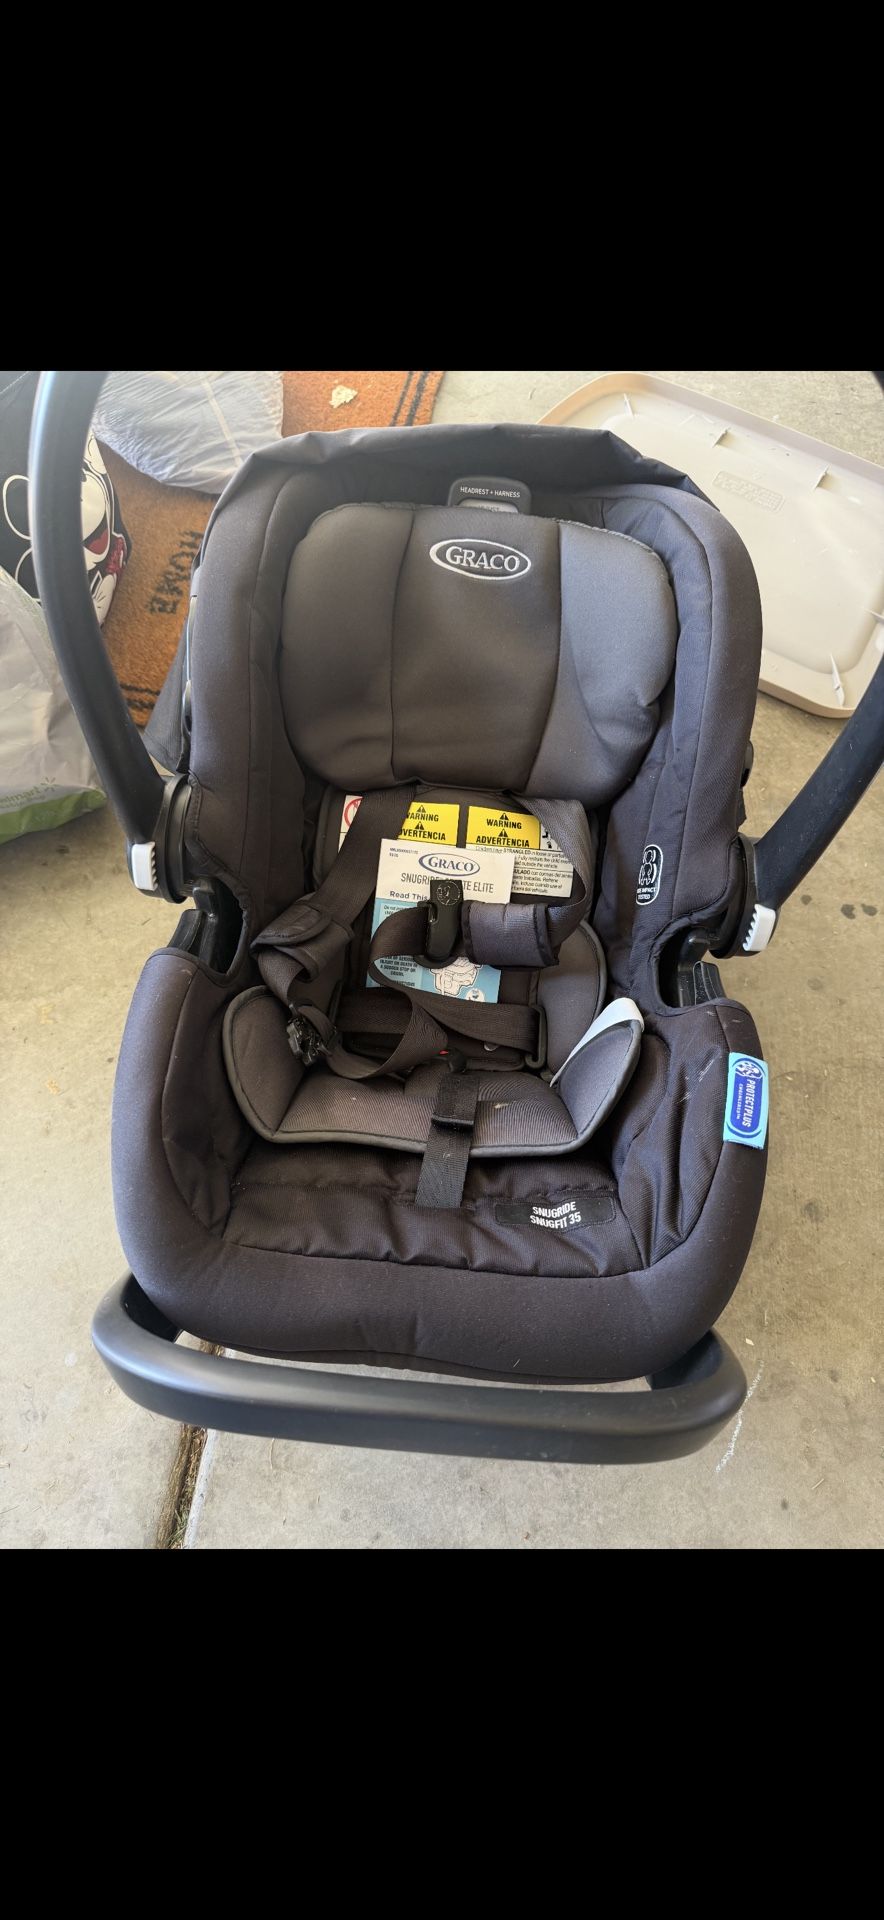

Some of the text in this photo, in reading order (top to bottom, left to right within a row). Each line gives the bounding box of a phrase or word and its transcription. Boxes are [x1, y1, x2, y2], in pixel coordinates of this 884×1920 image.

[460, 486, 489, 495] HEADREST
[494, 490, 520, 498] HARNESS
[445, 545, 520, 572] GRACO
[486, 818, 522, 830] WARNING
[475, 835, 530, 848] ADVERTENCIA
[428, 856, 474, 872] GRACO
[473, 881, 494, 893] ELITE
[390, 890, 428, 901] Read This
[741, 1079, 756, 1128] PROTECTPLUS
[532, 1201, 577, 1218] SNUGRIDE
[529, 1211, 582, 1229] SNUGFIT 35
